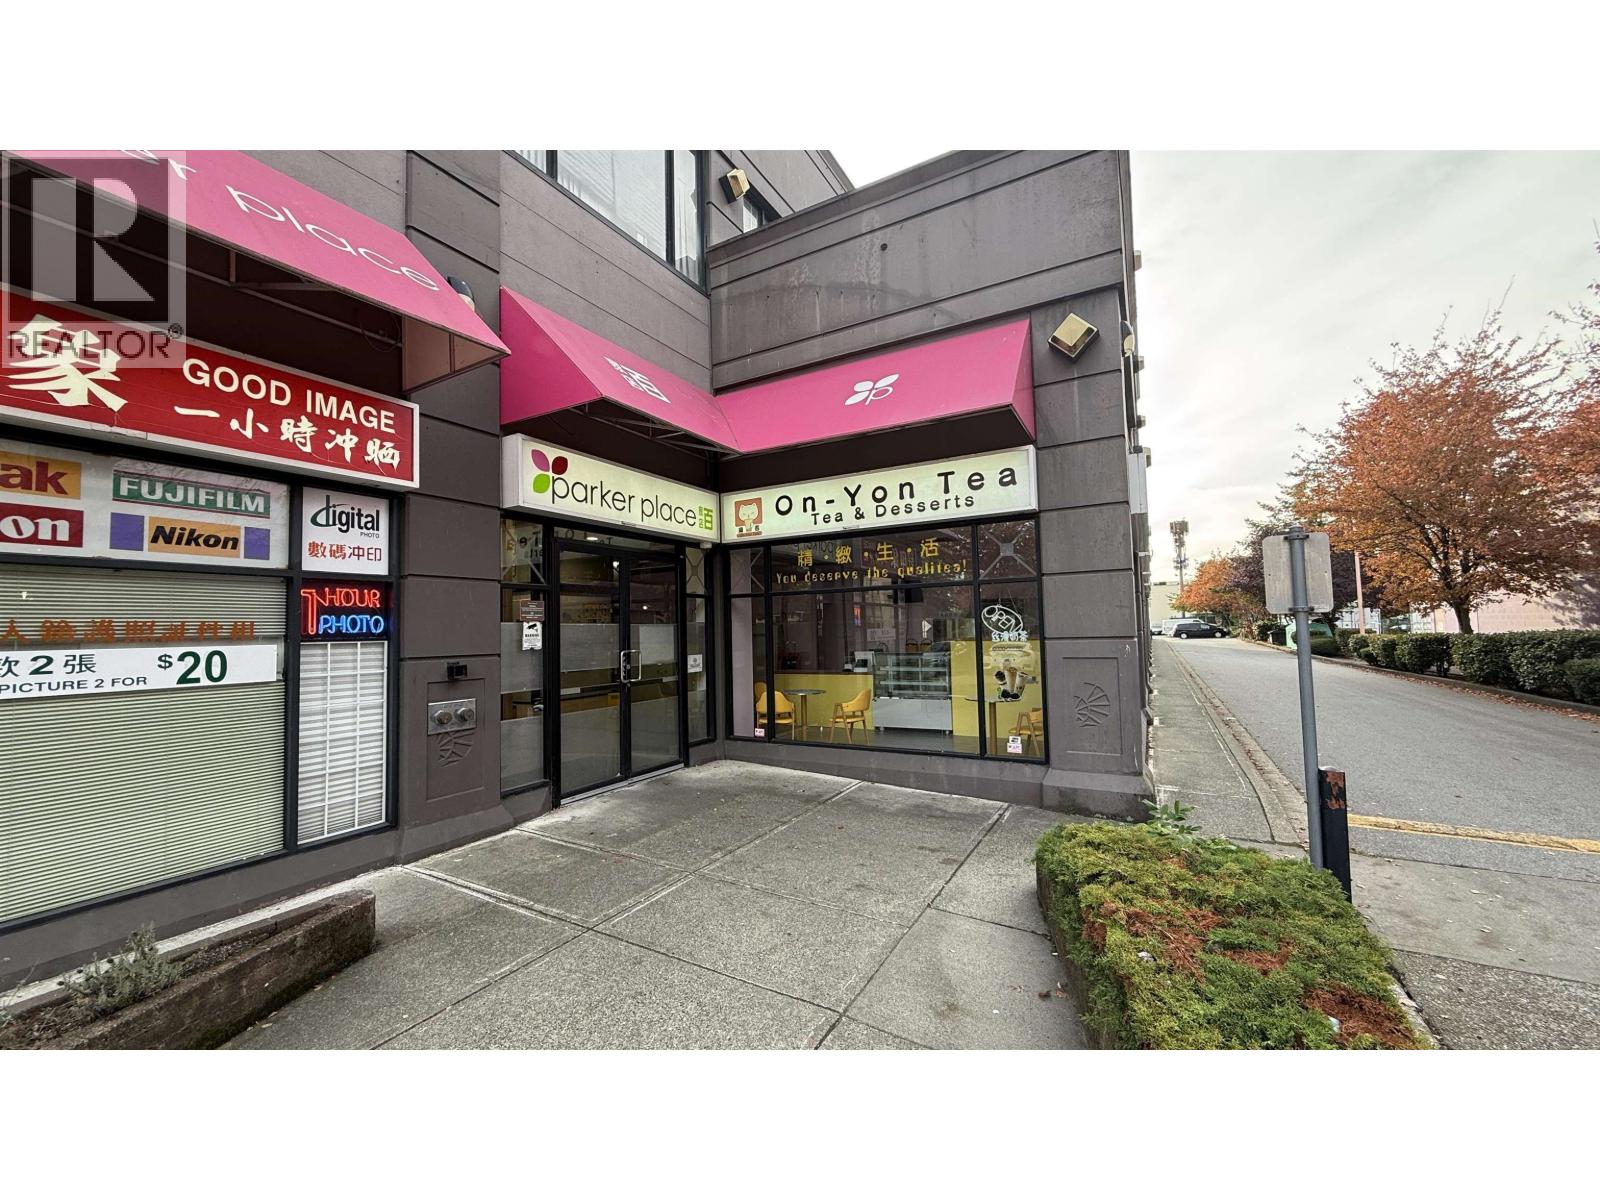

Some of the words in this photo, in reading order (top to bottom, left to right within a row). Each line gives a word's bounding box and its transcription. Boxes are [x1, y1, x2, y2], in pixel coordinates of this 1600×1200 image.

[225, 184, 440, 291] place
[182, 358, 291, 406] GOOD
[306, 389, 396, 434] IMAGE
[119, 477, 265, 513] FUJIFILM
[551, 475, 635, 513] parker
[641, 494, 697, 527] place
[775, 481, 915, 516] On-Yon
[937, 466, 1018, 494] Tea
[310, 494, 380, 534] digital
[811, 512, 844, 526] Tea
[854, 506, 866, 520] &
[875, 494, 975, 518] Desserts
[150, 525, 240, 551] Nikon
[360, 531, 380, 539] PHOTO
[776, 572, 797, 585] You
[804, 568, 859, 582] deserve
[867, 566, 889, 579] the
[301, 589, 316, 635] 1
[321, 588, 381, 608] HOUR
[318, 614, 385, 634] PHOTO
[984, 606, 1022, 633] OPEN
[0, 680, 88, 694] PICTURE
[94, 678, 105, 689] 2
[111, 676, 148, 688] FOR
[157, 649, 228, 686] $20
